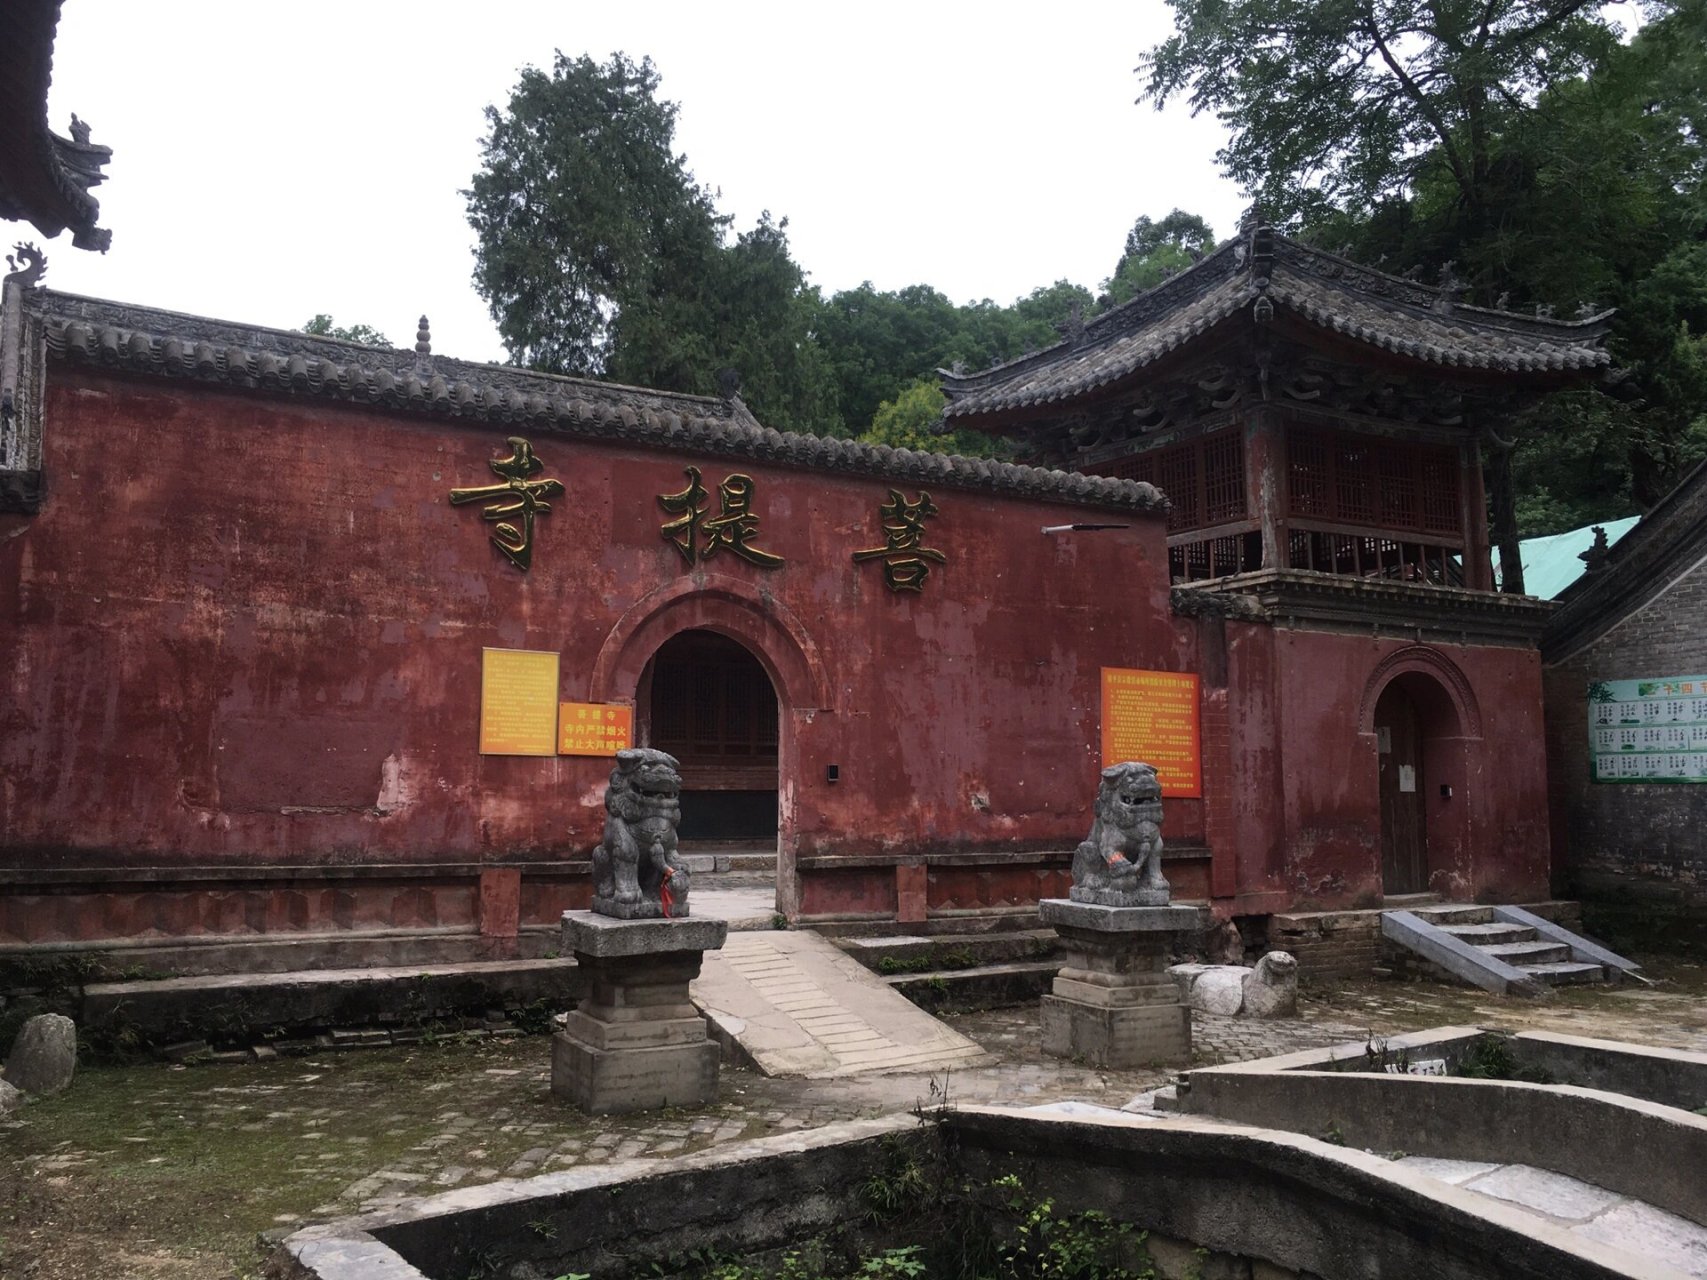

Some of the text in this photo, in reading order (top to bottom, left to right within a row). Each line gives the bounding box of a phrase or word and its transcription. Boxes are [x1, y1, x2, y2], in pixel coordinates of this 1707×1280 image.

[565, 724, 626, 737] 寺内严禁烟火
